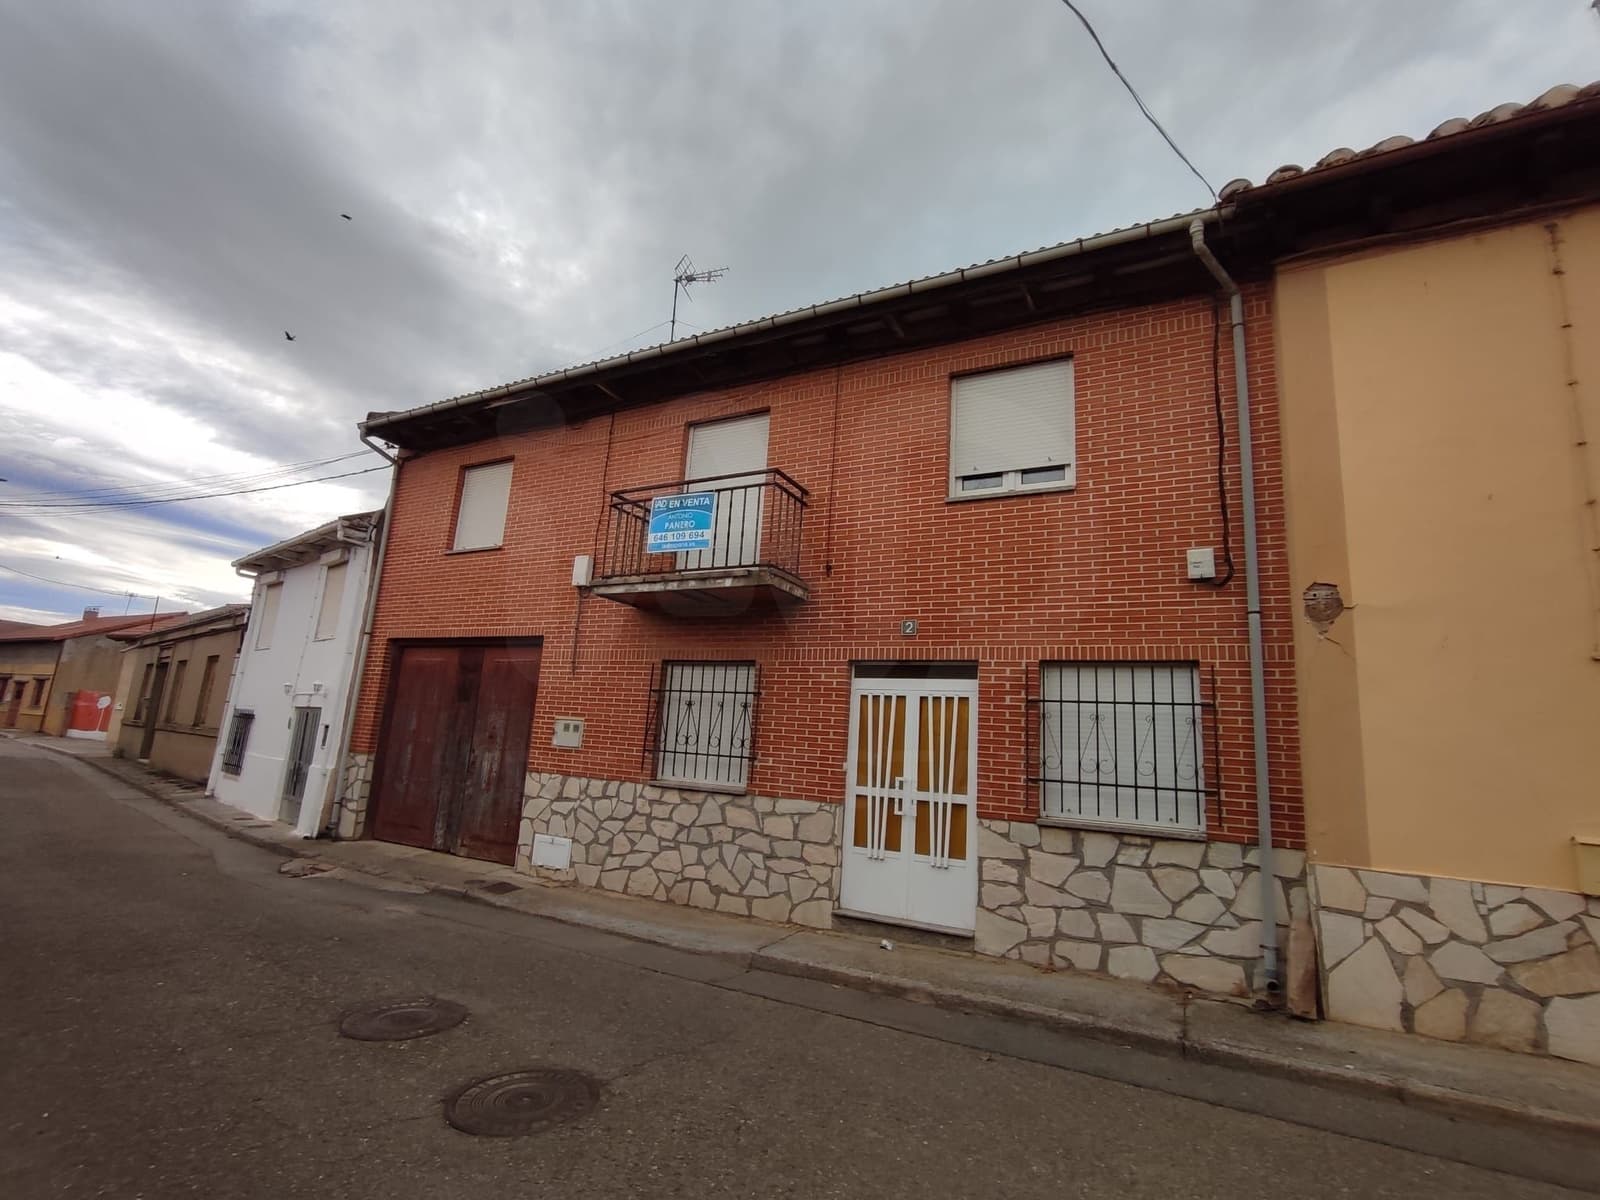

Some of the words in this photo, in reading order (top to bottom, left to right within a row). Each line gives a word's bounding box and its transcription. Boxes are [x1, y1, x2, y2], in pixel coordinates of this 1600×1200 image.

[669, 499, 680, 508] EN
[682, 497, 710, 507] VENTA
[664, 520, 696, 530] PANERO
[653, 534, 668, 542] 646
[672, 532, 685, 540] 109
[688, 531, 705, 539] 694
[905, 621, 913, 633] 2
